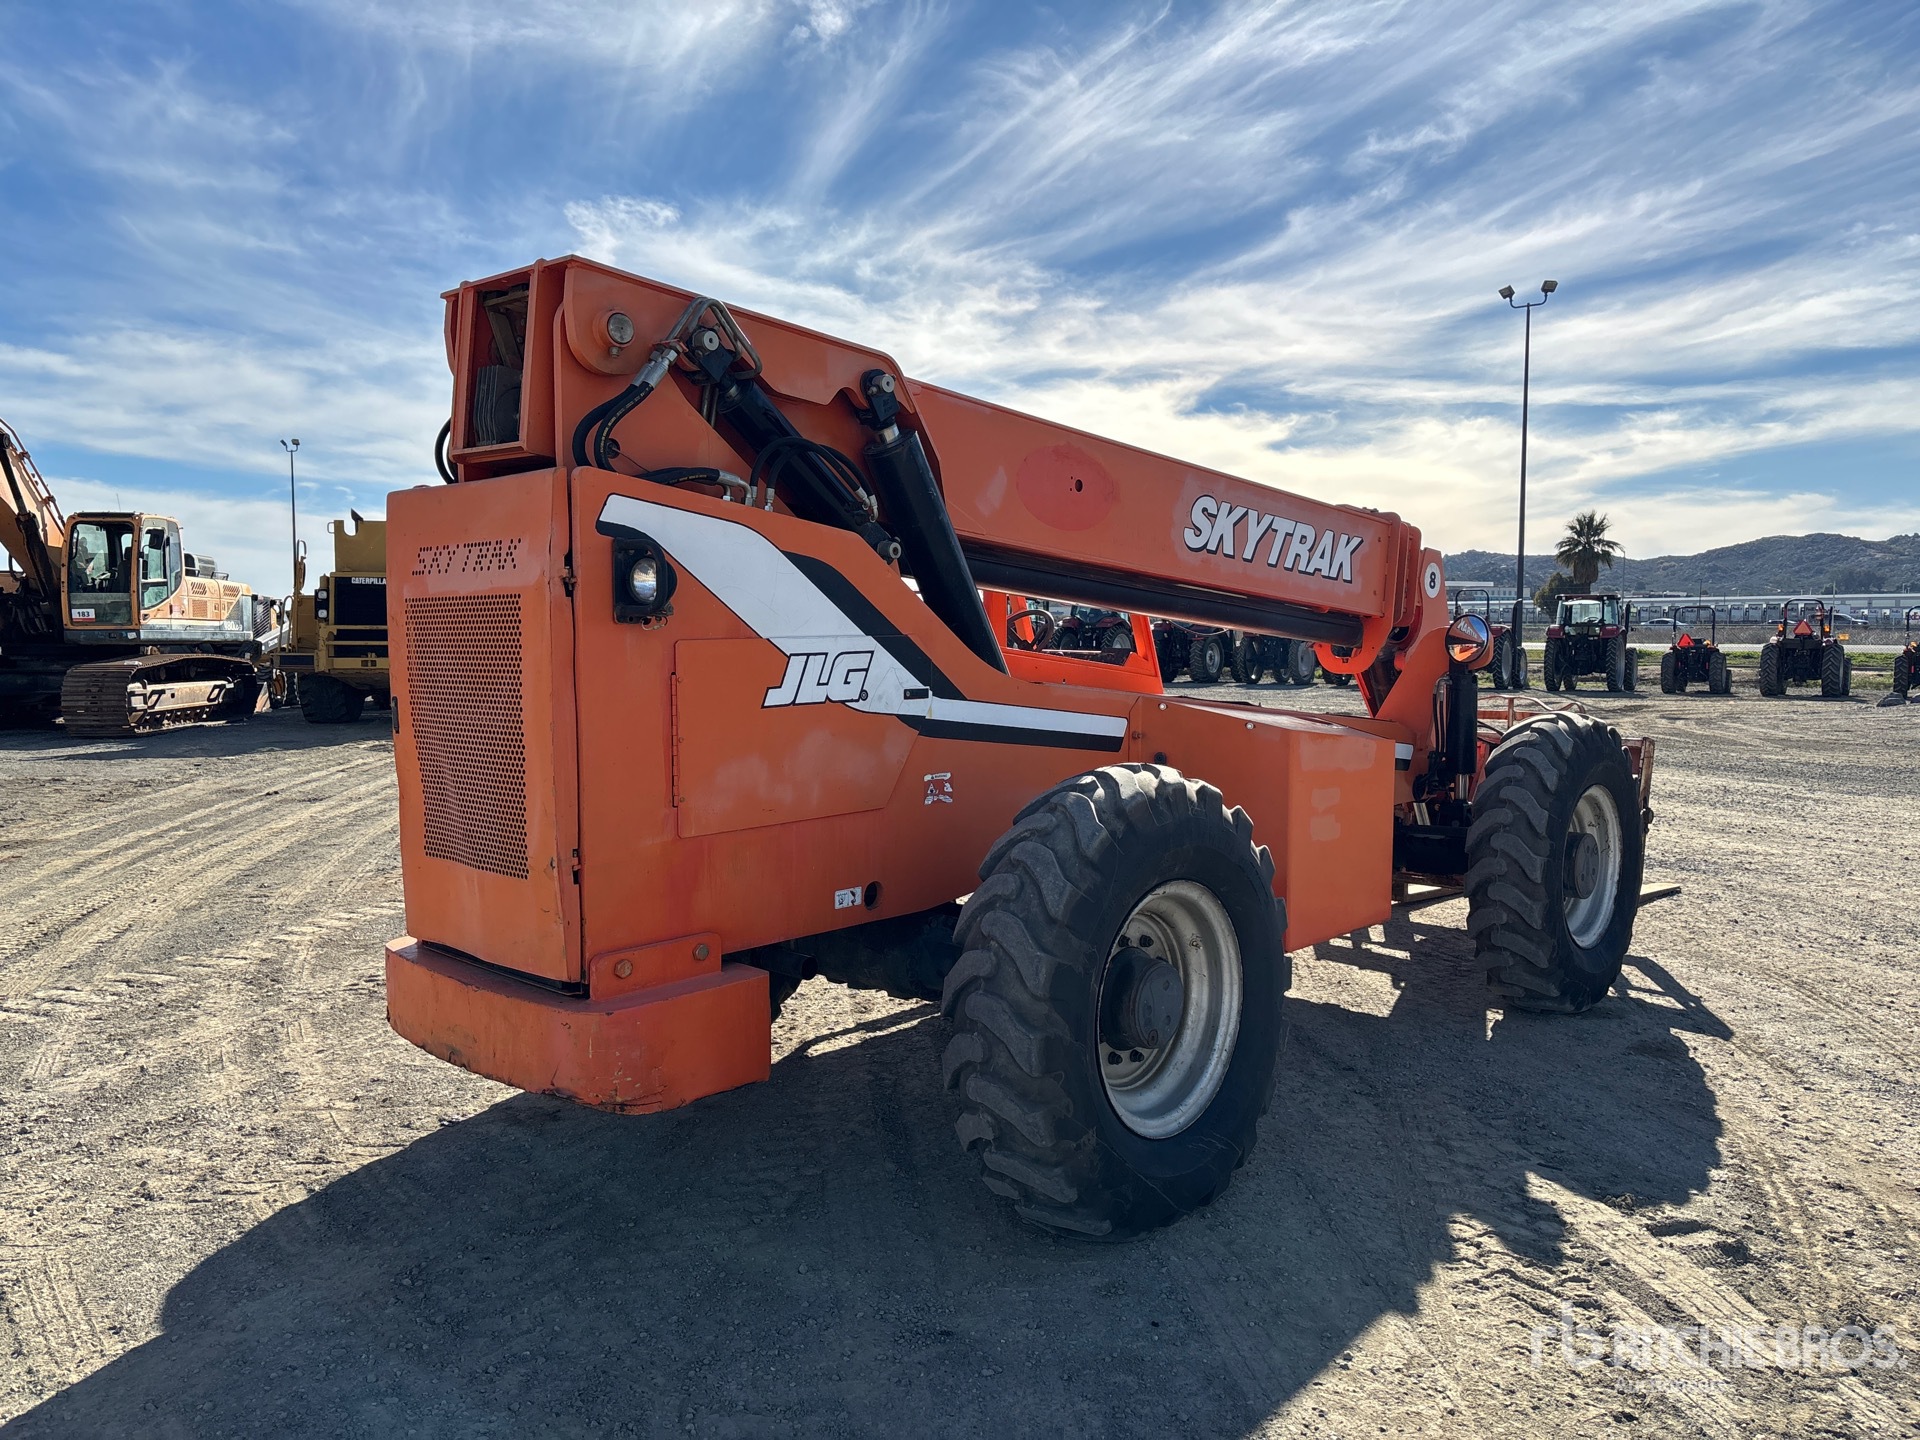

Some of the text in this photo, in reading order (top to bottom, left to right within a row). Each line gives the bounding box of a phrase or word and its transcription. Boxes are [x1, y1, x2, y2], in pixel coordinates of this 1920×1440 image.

[411, 537, 521, 576] SKYTRAK
[1183, 494, 1363, 584] SKYTRAK
[351, 577, 387, 585] CATERPILLA
[1428, 570, 1437, 590] 8
[761, 650, 874, 709] JLG
